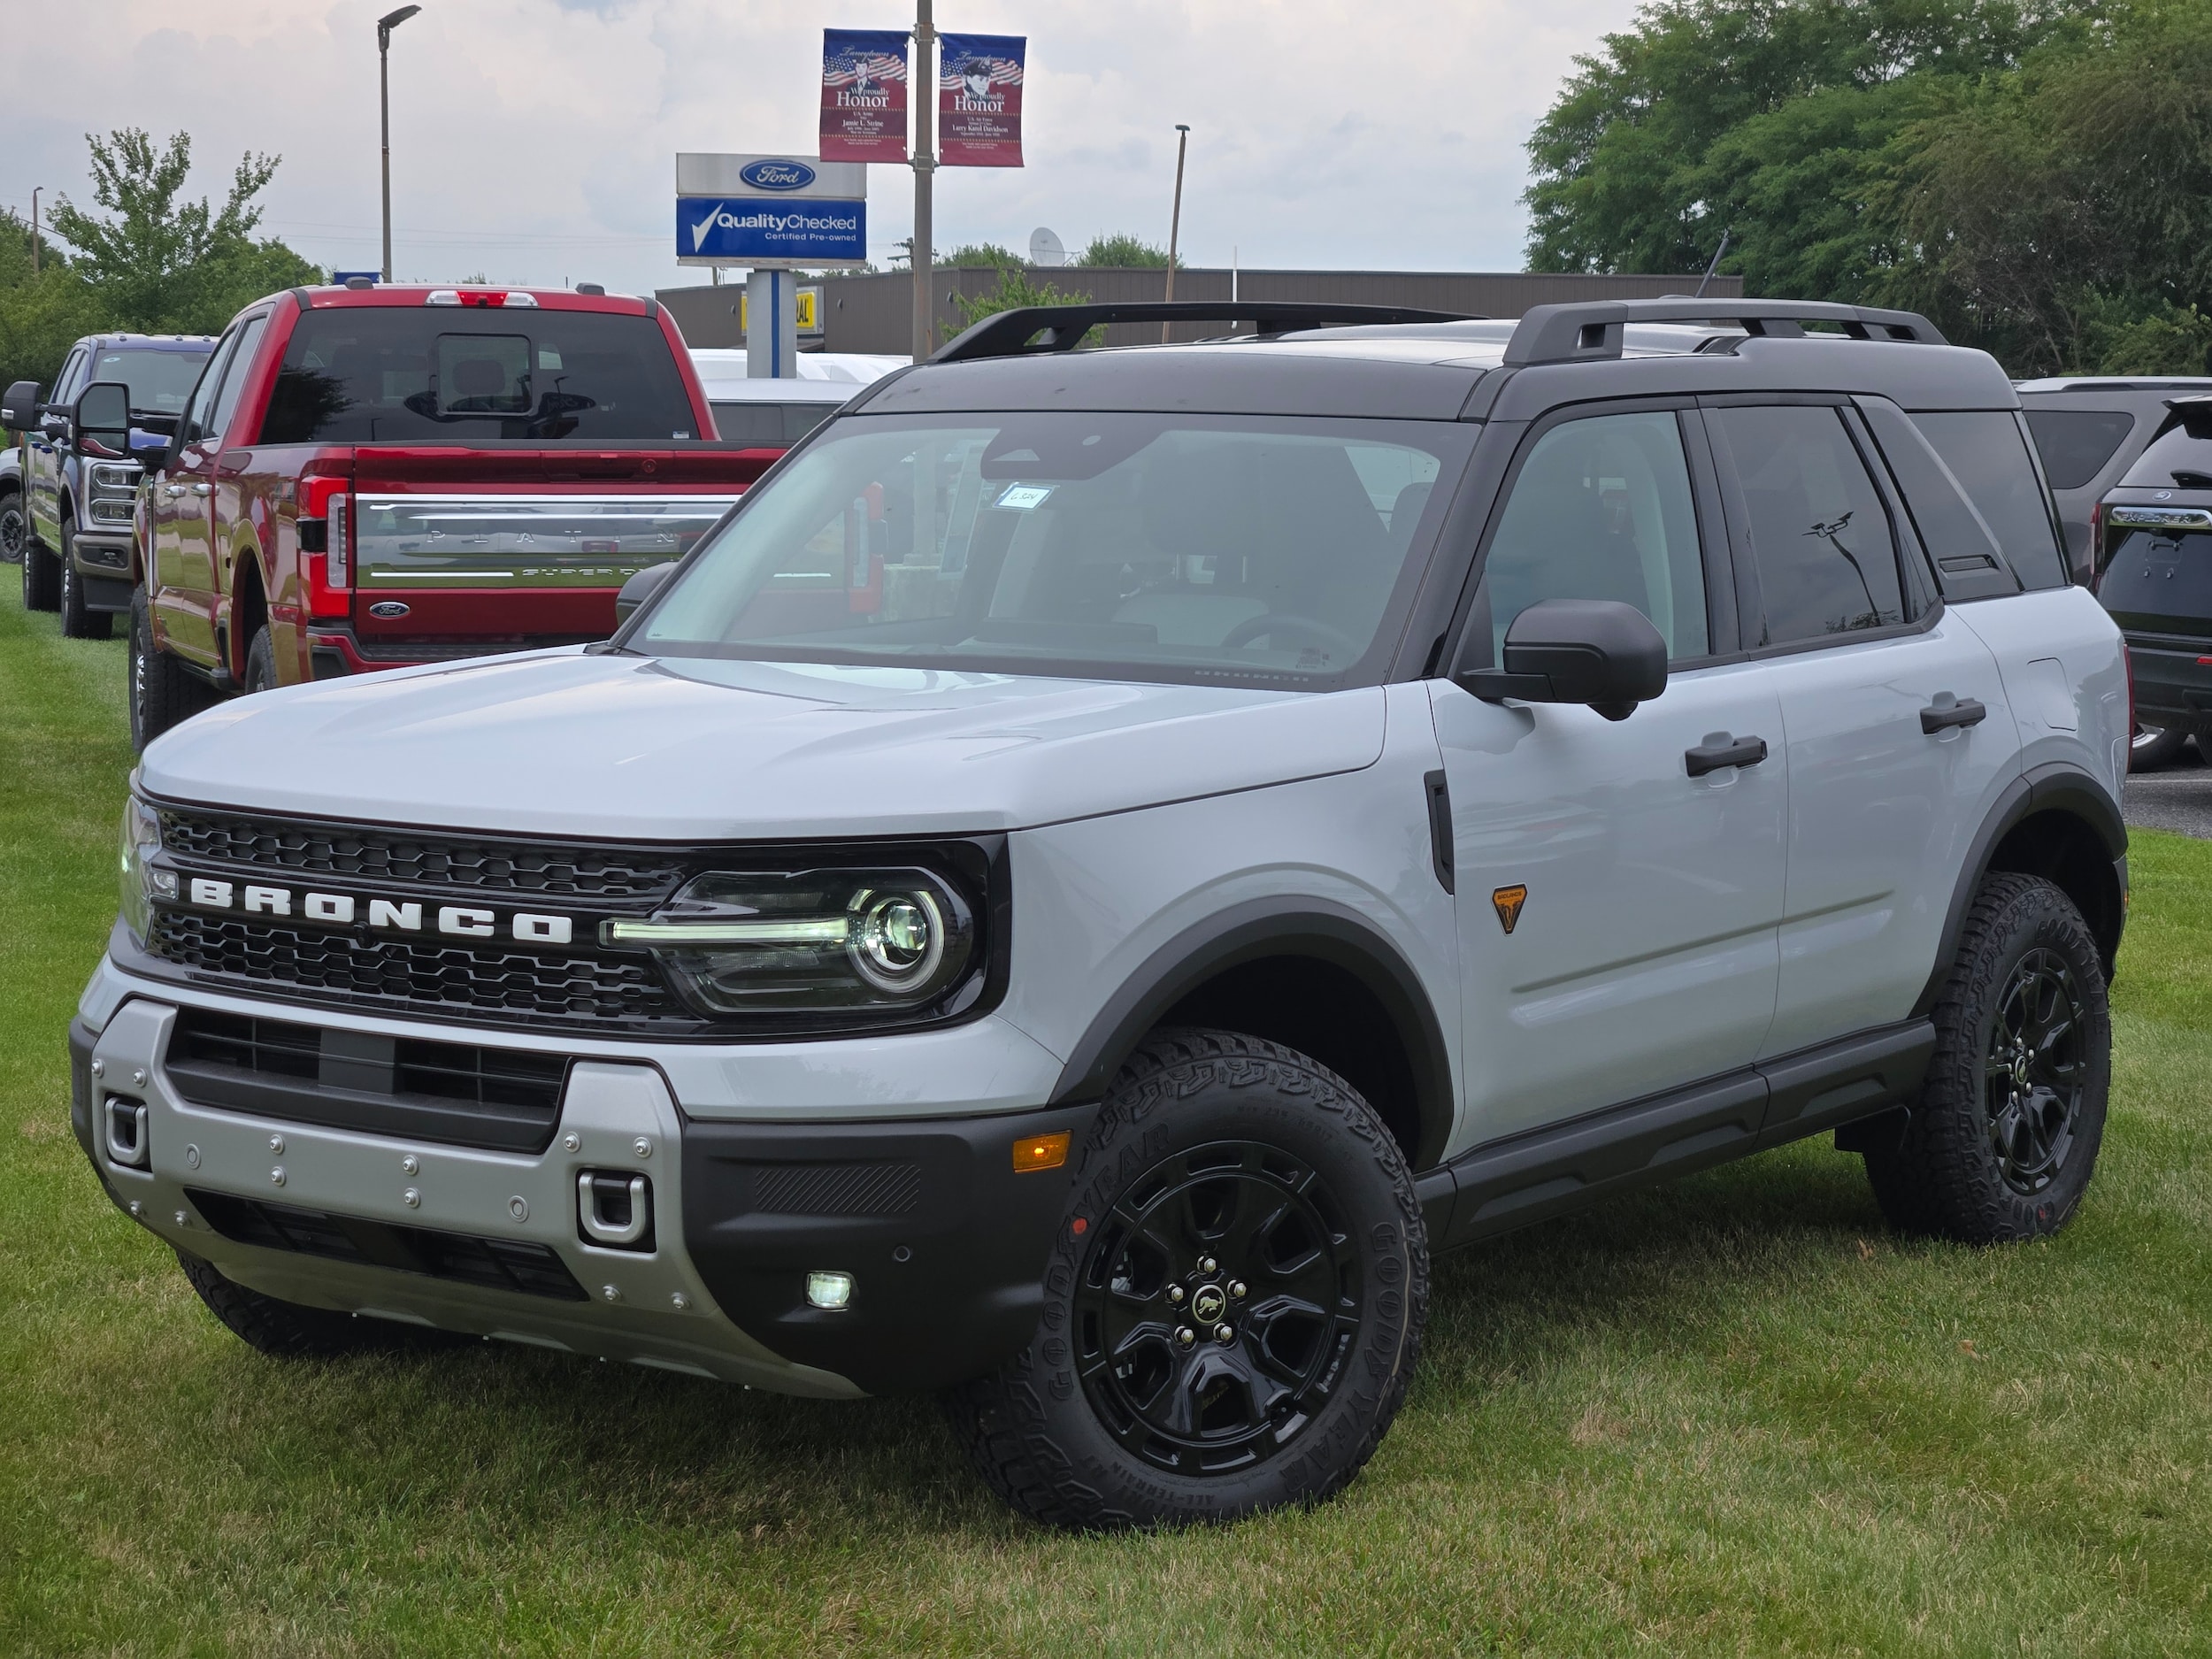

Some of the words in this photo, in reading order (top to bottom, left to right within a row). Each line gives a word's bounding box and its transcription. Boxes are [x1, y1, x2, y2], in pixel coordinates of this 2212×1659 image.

[836, 90, 890, 107] Honor
[862, 87, 890, 96] proudly
[954, 95, 1005, 112] Honor
[757, 165, 800, 183] Ford
[717, 212, 856, 231] QualityChecked
[809, 233, 856, 242] Pre-owned
[2121, 512, 2192, 524] EXPLORER
[379, 604, 402, 615] Ford
[190, 877, 572, 944] BRONCO
[1042, 1122, 1170, 1401] GOODYEAR
[1279, 1221, 1405, 1492] GOODYEAR
